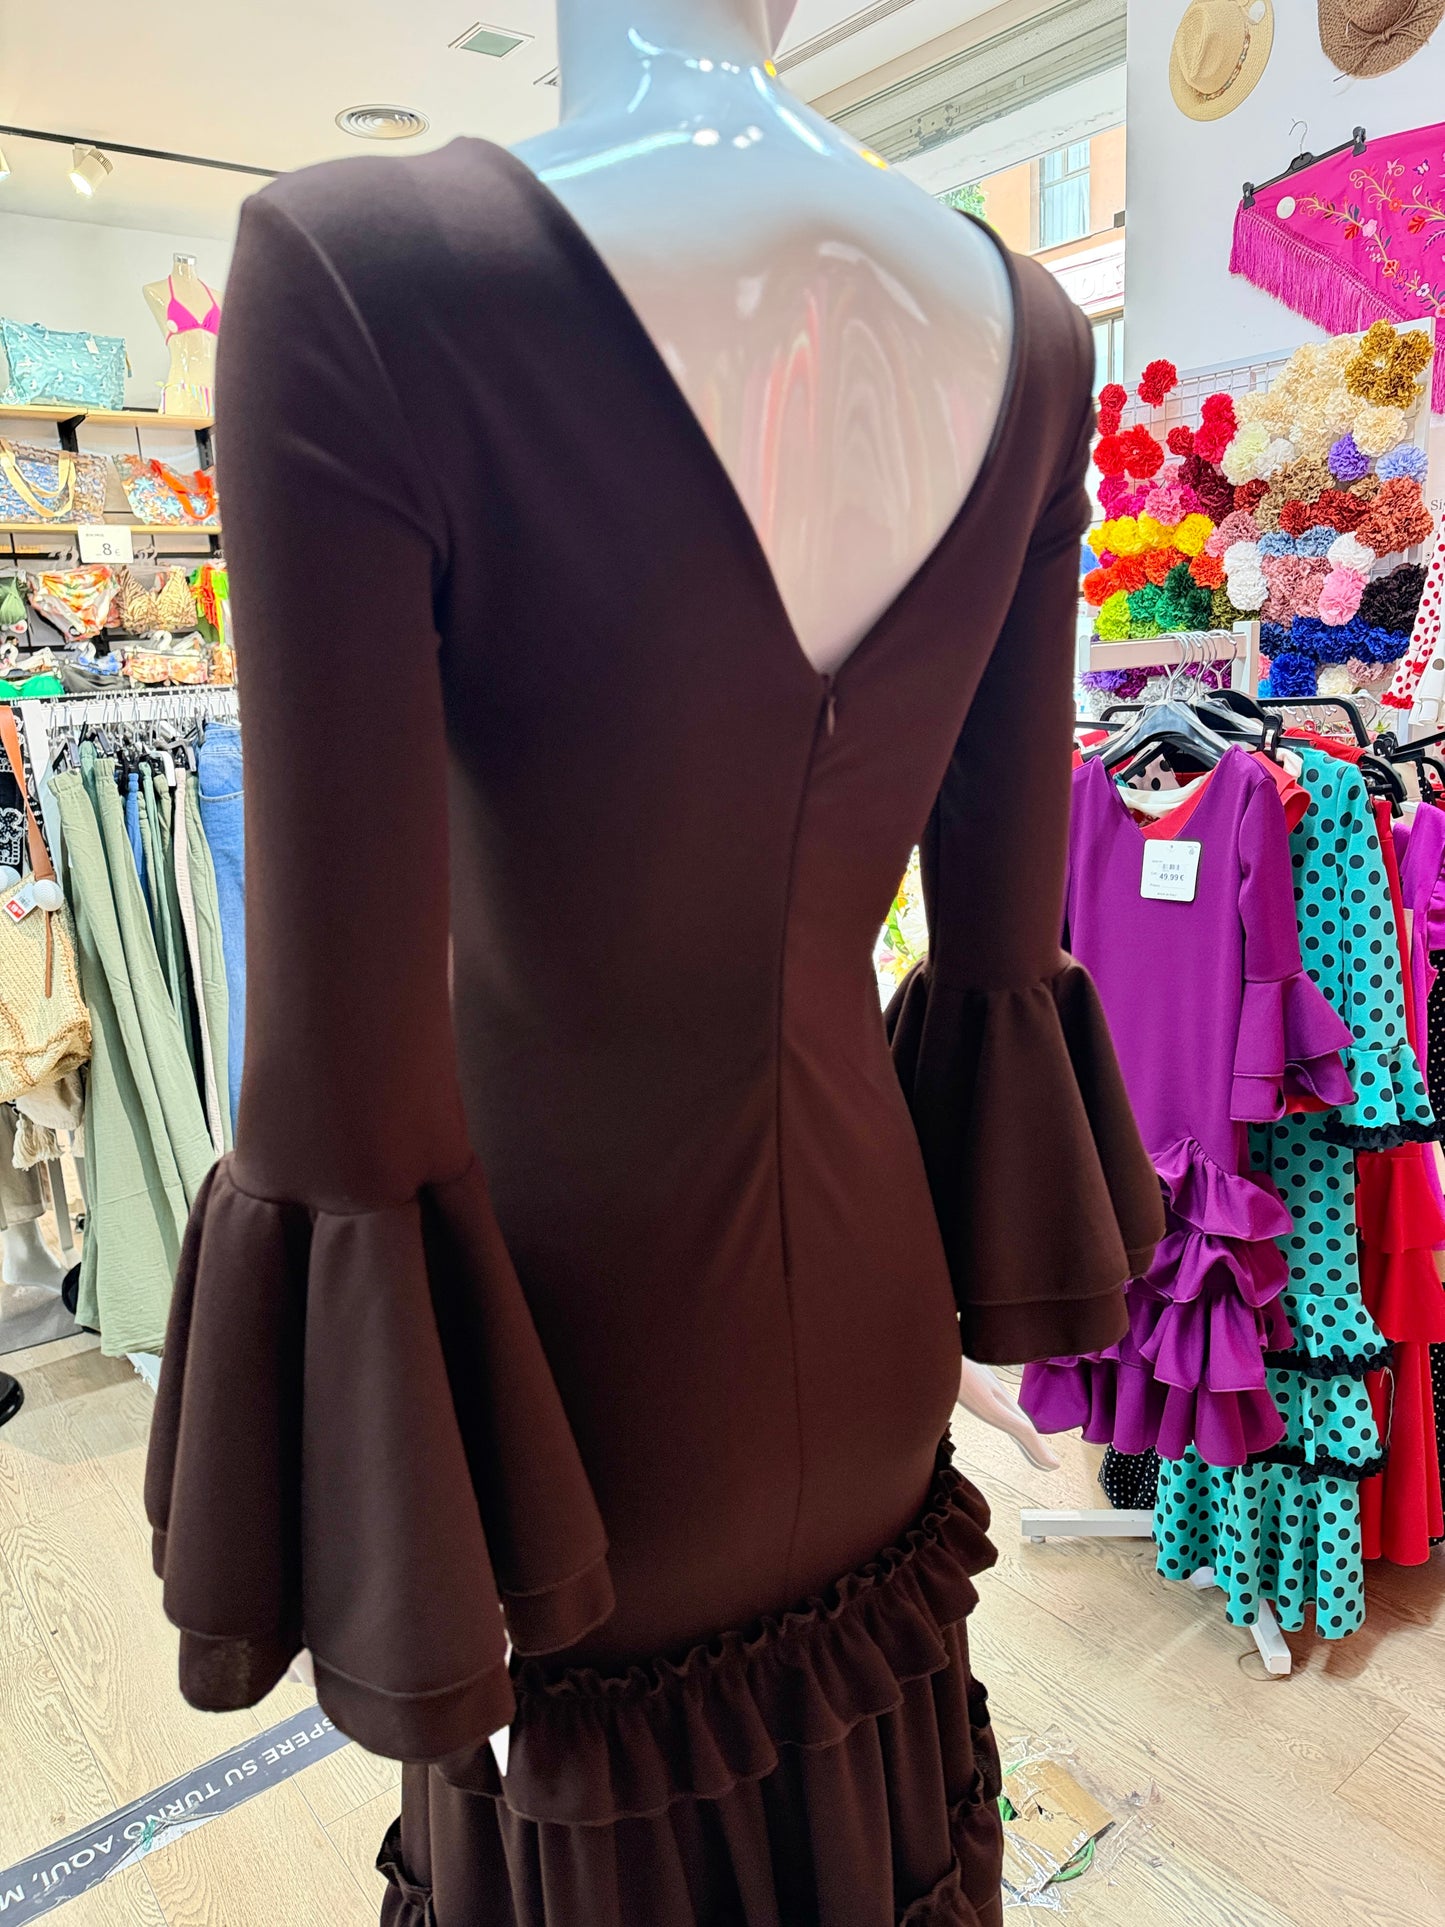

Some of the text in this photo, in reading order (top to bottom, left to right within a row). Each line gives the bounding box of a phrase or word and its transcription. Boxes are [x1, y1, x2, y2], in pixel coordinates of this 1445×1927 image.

[102, 543, 112, 556] 8
[262, 1716, 336, 1766] SPERE
[225, 1759, 258, 1787] SU
